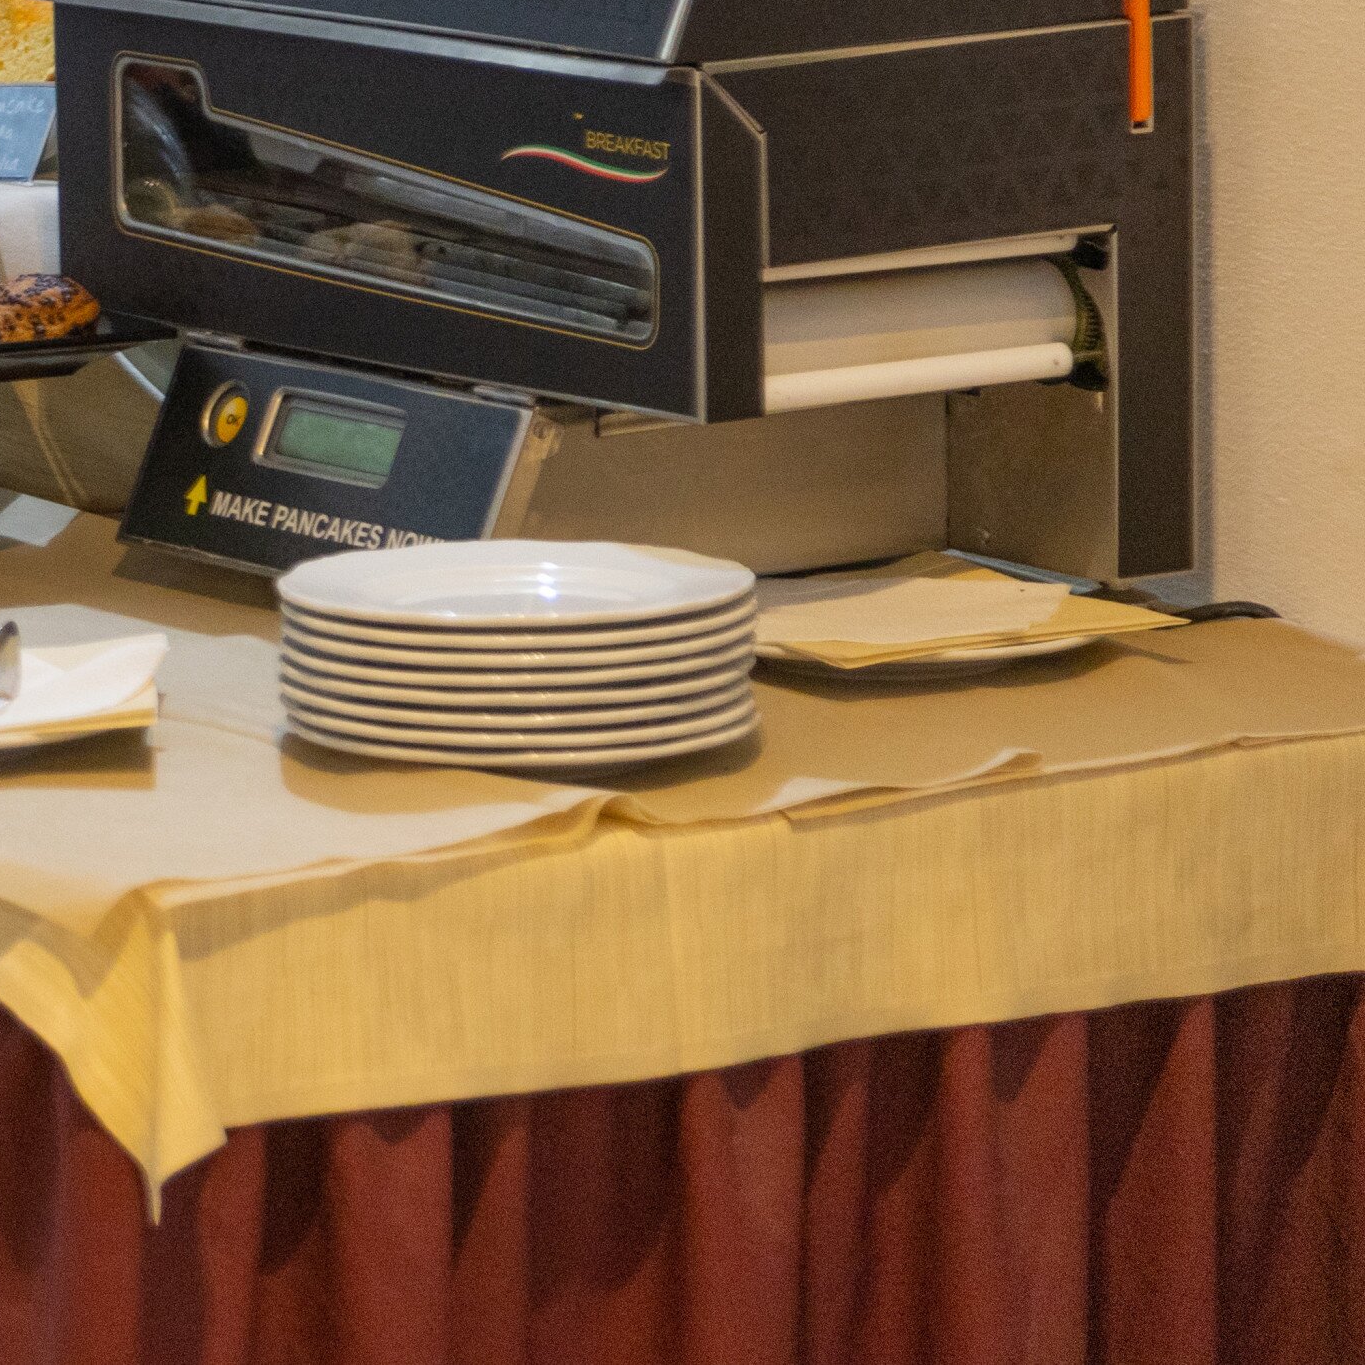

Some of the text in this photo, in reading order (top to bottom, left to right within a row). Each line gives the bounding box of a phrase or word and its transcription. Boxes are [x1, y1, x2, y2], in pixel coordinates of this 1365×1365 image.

[584, 129, 671, 160] BREAKFAST
[209, 489, 271, 527] MAKE
[272, 504, 384, 550] PANCAKES
